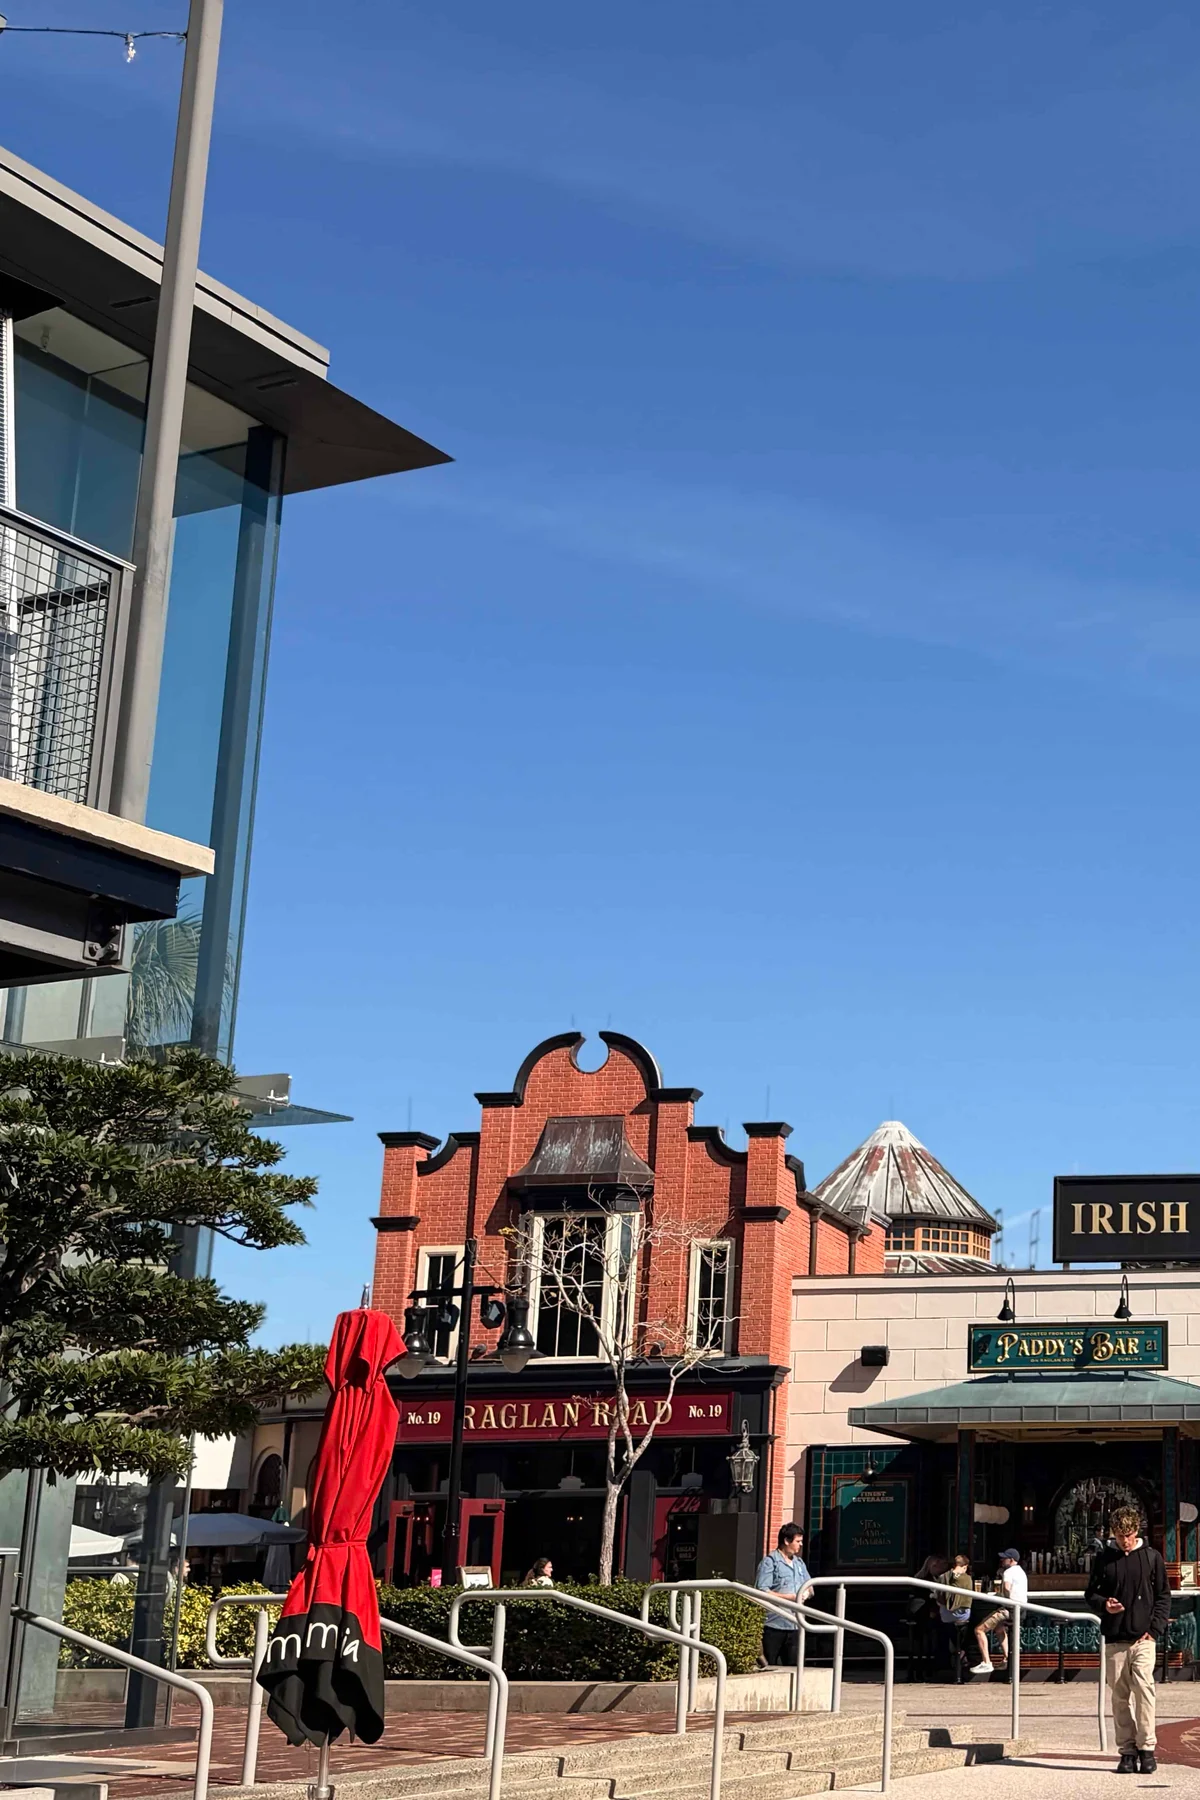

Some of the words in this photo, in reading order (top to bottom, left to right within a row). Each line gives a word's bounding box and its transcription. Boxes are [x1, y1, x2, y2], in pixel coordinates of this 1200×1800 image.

[1071, 1201, 1190, 1235] IRISH
[997, 1332, 1084, 1364] PADDY'S
[1091, 1331, 1139, 1361] BAR
[1146, 1340, 1157, 1352] 21
[407, 1412, 425, 1425] No.
[428, 1411, 441, 1424] 19
[462, 1402, 580, 1430] RAGLAN
[688, 1405, 704, 1418] No.
[709, 1404, 723, 1418] 19
